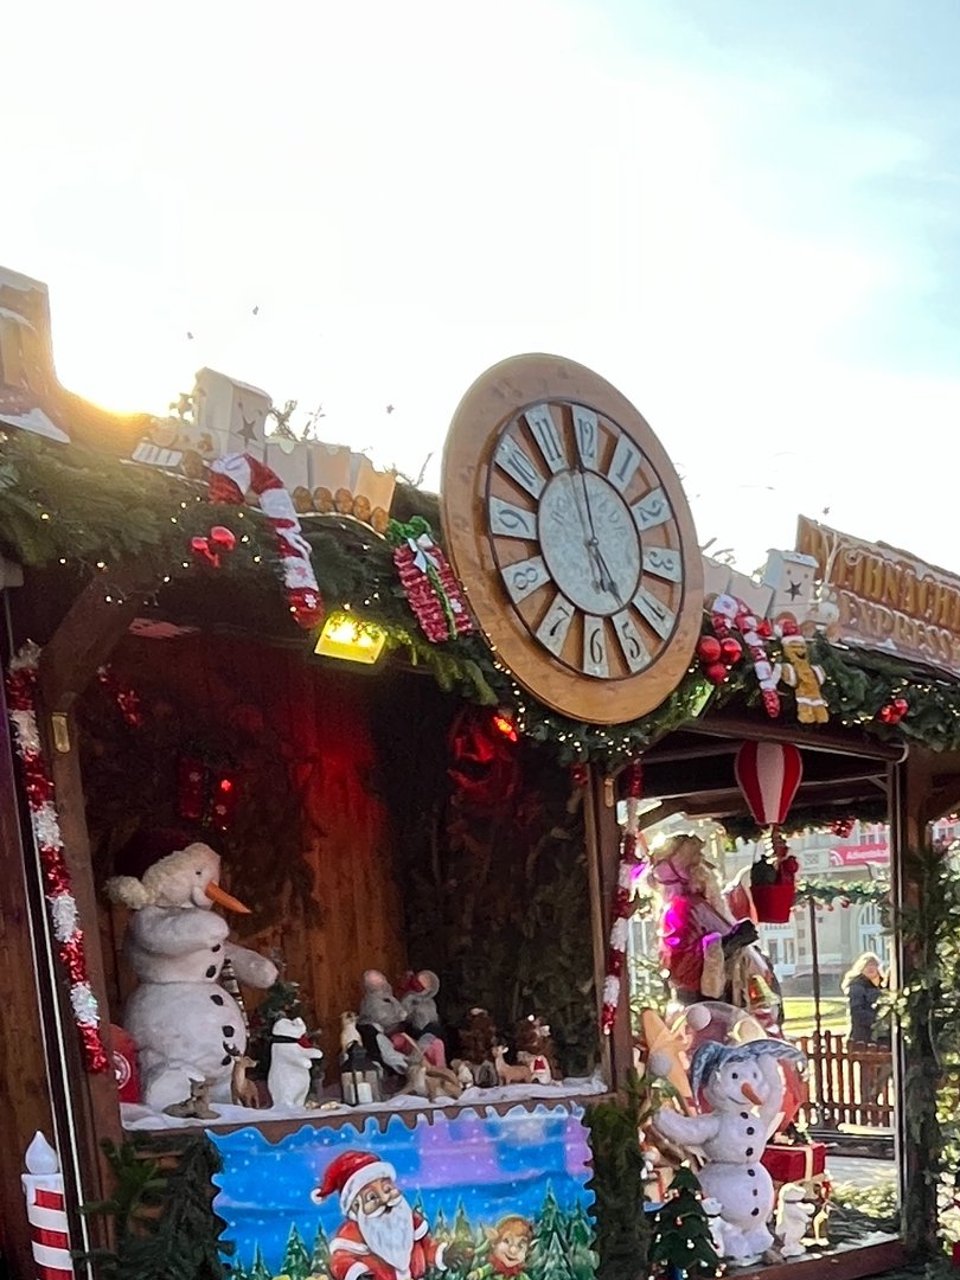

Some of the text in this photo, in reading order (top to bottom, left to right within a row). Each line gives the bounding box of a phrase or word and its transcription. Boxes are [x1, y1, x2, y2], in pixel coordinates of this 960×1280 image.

[534, 417, 563, 463] 11
[577, 417, 595, 459] 12
[506, 451, 540, 488] 10
[615, 450, 634, 483] 1
[498, 508, 530, 533] 9
[639, 500, 666, 523] 2
[650, 550, 675, 572] 3
[512, 566, 539, 591] 8
[548, 605, 571, 637] 7
[641, 595, 667, 622] 4
[840, 588, 953, 660] EXPRESS
[589, 628, 604, 665] 6
[621, 621, 642, 660] 5
